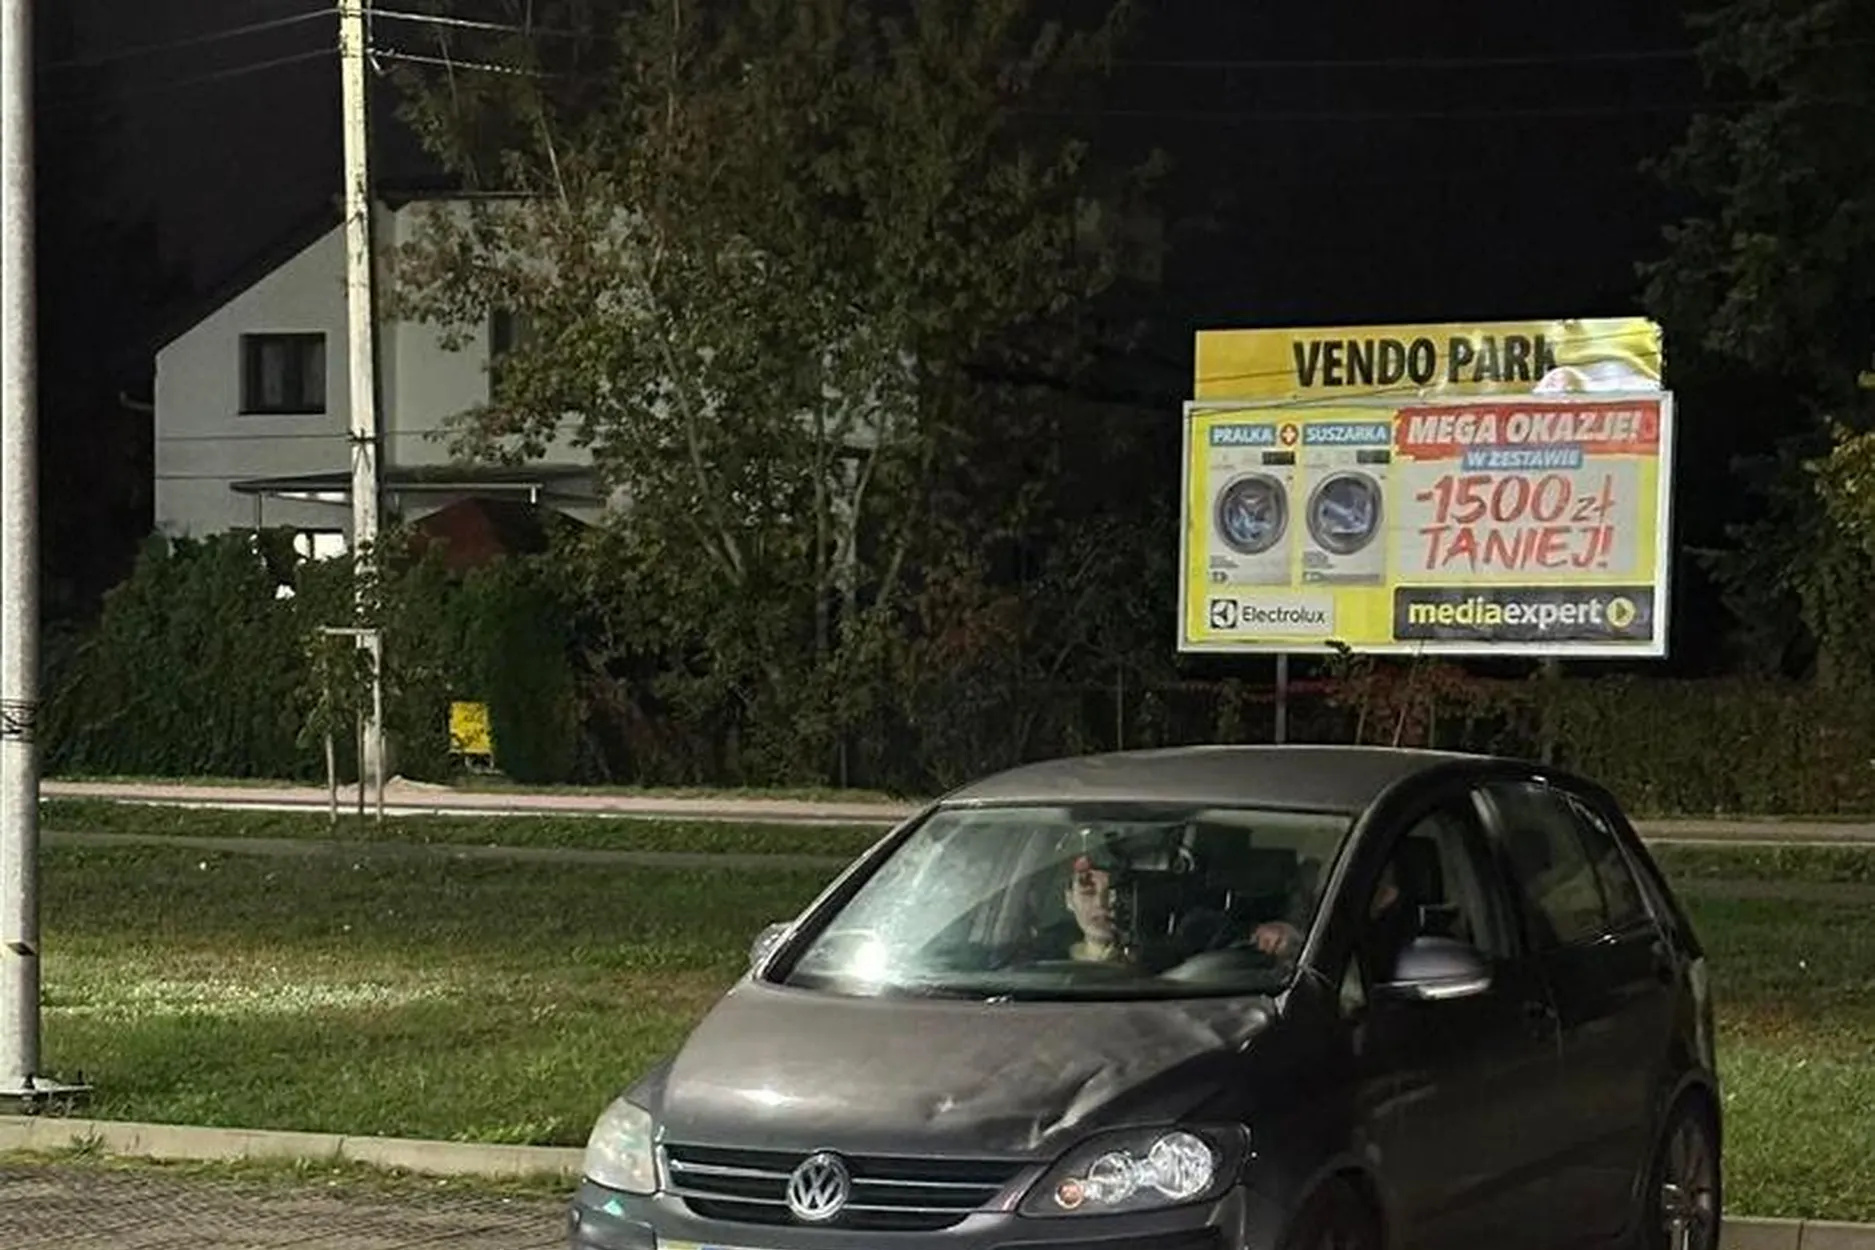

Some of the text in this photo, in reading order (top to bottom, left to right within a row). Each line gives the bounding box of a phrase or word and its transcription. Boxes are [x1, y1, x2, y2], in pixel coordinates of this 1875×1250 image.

[1293, 337, 1436, 387] VENDO
[1213, 426, 1274, 443] PRALKA
[1306, 425, 1387, 443] SUSZARKA
[1407, 410, 1642, 444] MEGA OKAZJE!
[1467, 451, 1489, 467] W
[1416, 473, 1615, 524] -1500 zł
[1419, 525, 1615, 572] TANIEJ!
[1242, 606, 1325, 624] Electrolux
[1408, 596, 1603, 629] mediaexpert
